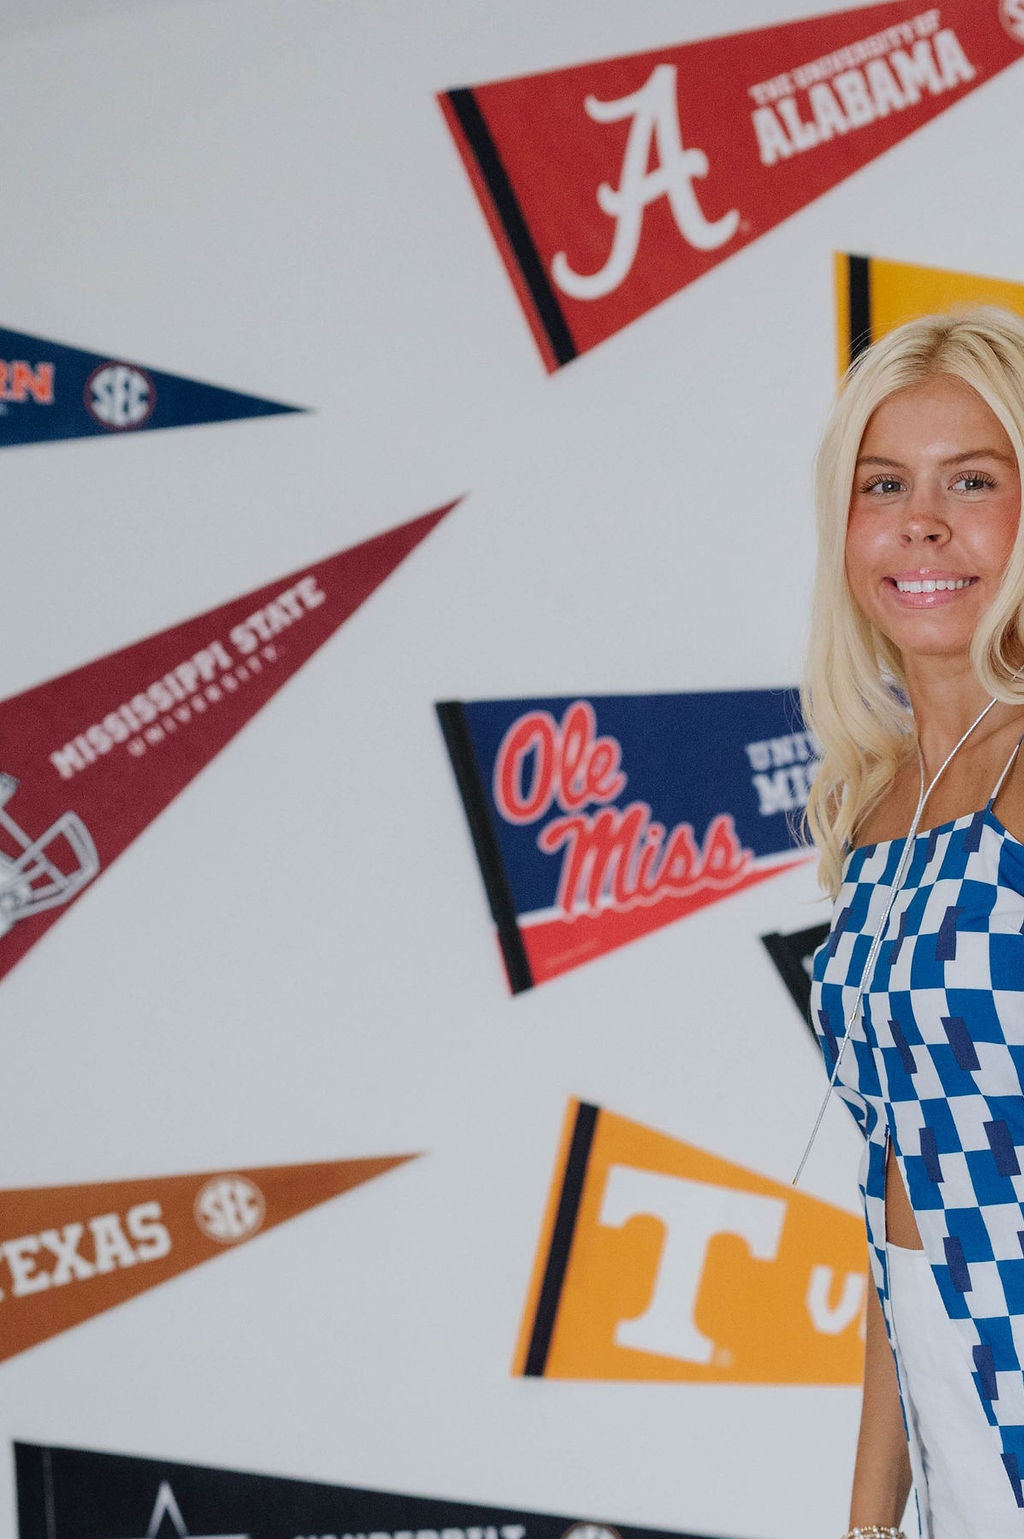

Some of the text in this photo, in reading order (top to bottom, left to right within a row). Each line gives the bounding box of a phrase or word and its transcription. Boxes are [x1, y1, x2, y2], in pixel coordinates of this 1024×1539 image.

[751, 27, 977, 167] ALABAMA
[551, 63, 741, 301] A
[51, 575, 326, 779] MISSISSIPPI STATE
[494, 700, 626, 824] Ole
[537, 801, 753, 922] Miss
[0, 1200, 172, 1298] EXAS
[599, 1163, 788, 1365] T
